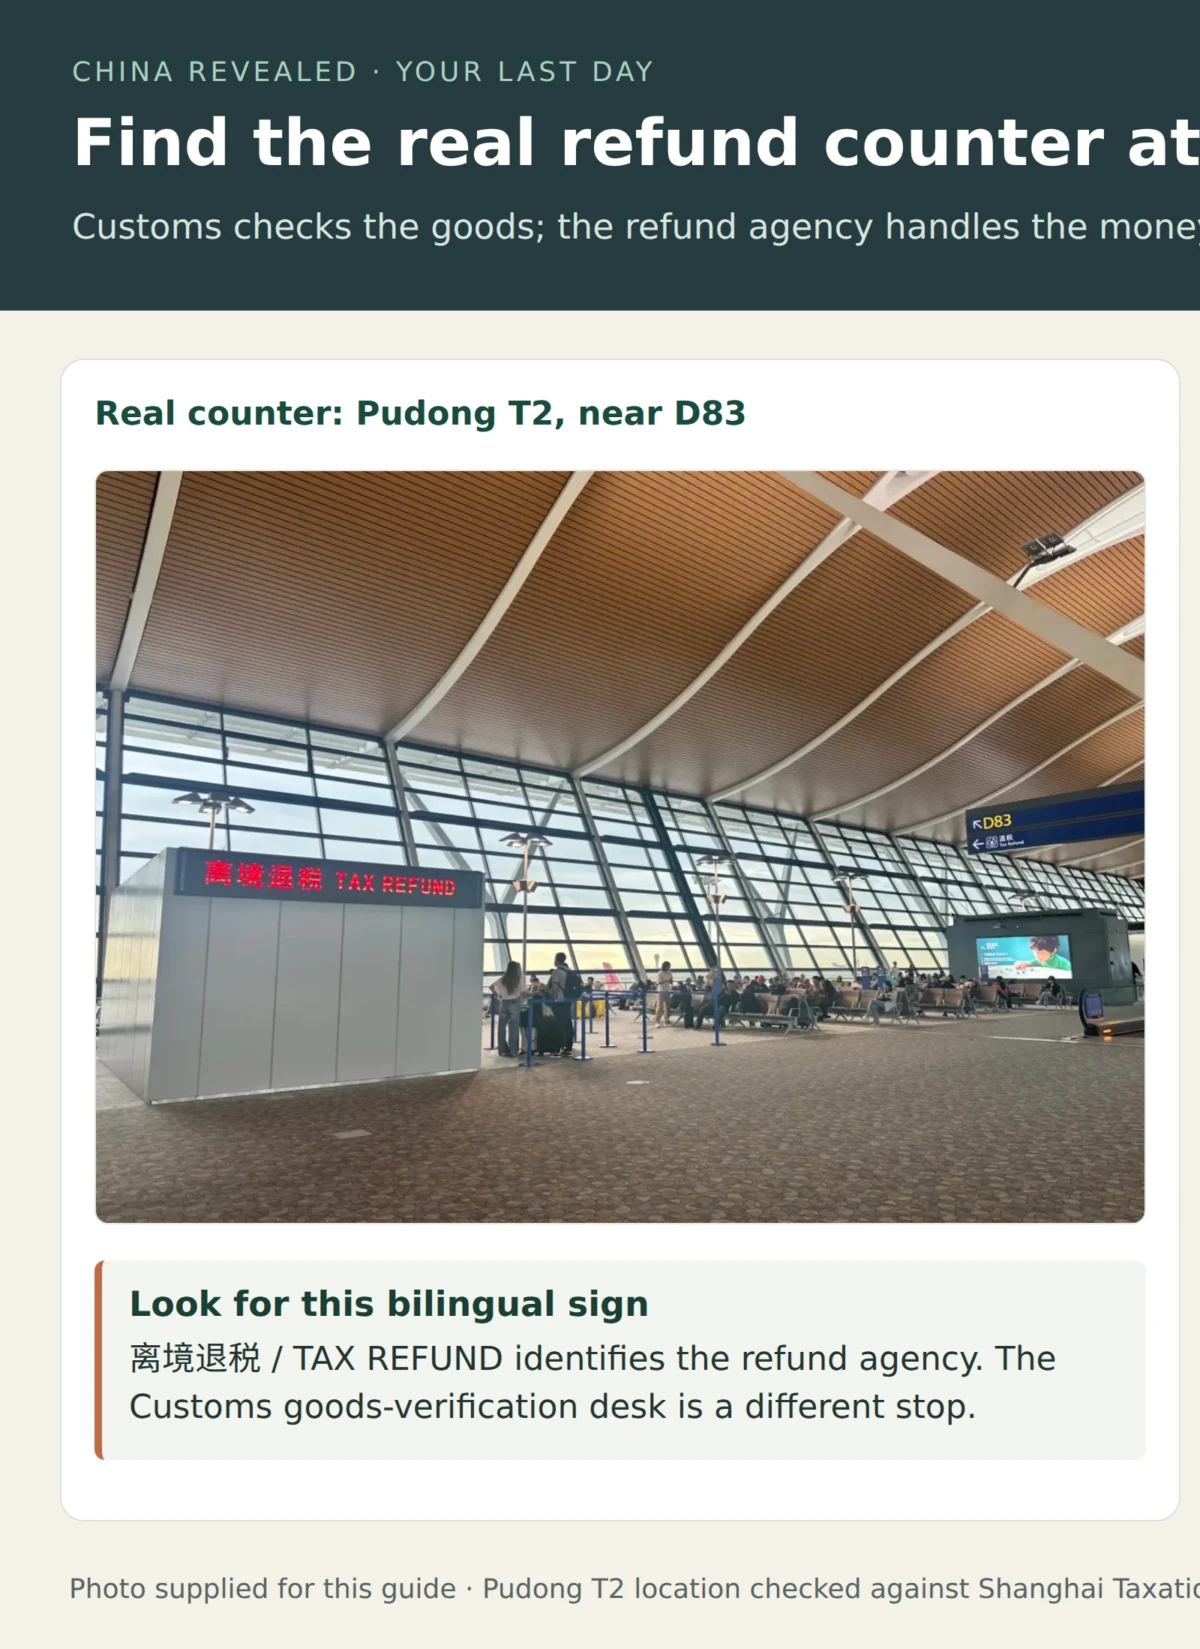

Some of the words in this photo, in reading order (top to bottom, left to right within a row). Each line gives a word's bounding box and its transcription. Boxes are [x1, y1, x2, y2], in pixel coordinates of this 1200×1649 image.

[983, 813, 1012, 830] D83
[204, 860, 324, 891] 离境退税
[335, 871, 375, 892] TAX
[381, 875, 456, 896] REFUND
